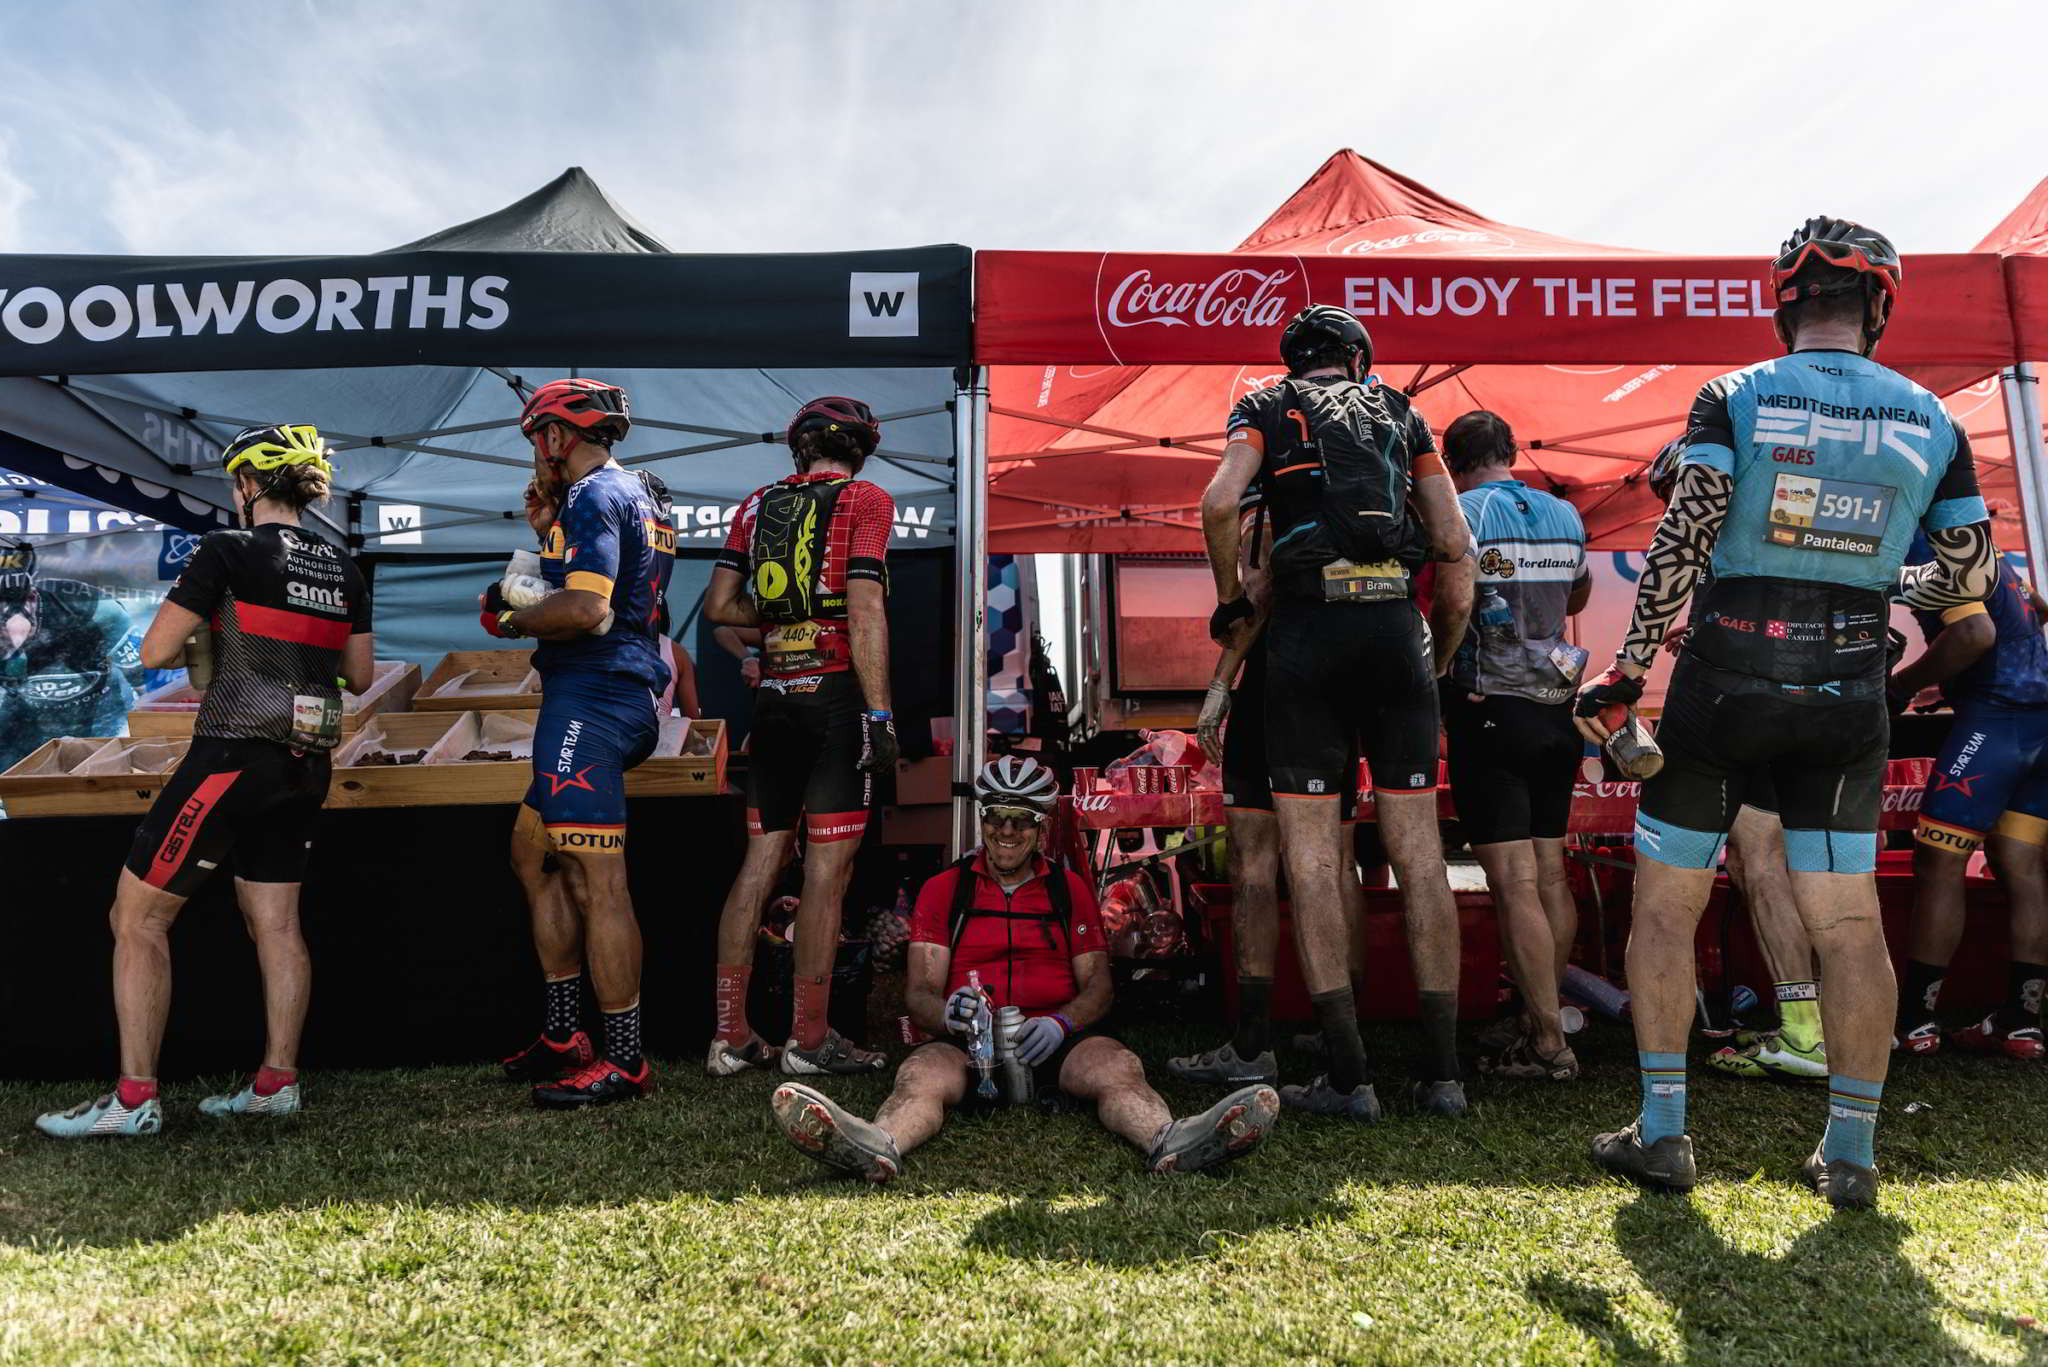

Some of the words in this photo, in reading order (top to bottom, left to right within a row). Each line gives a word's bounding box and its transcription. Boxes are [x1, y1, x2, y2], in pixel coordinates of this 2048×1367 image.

[0, 275, 510, 344] OOLWORTHS
[863, 290, 905, 318] W
[1108, 269, 1298, 328] Coca-Cola
[1344, 276, 1521, 317] ENJOY
[1533, 277, 1638, 318] THE
[1757, 393, 1931, 429] MEDITERRANEAN
[1771, 446, 1816, 466] GAES
[1819, 493, 1882, 523] 591-1
[651, 524, 677, 549] OTU
[1802, 533, 1874, 554] Pantaleon
[286, 553, 343, 573] AUTHORISED
[287, 563, 345, 583] DISTRIBUTOR
[1366, 580, 1393, 591] Bram
[1719, 615, 1757, 633] GAES
[563, 719, 584, 748] TEAM
[557, 747, 573, 774] STAR
[1949, 752, 1969, 777] STAR
[1963, 730, 1987, 757] TEAM
[692, 771, 706, 781] W
[559, 832, 624, 850] JOTUN
